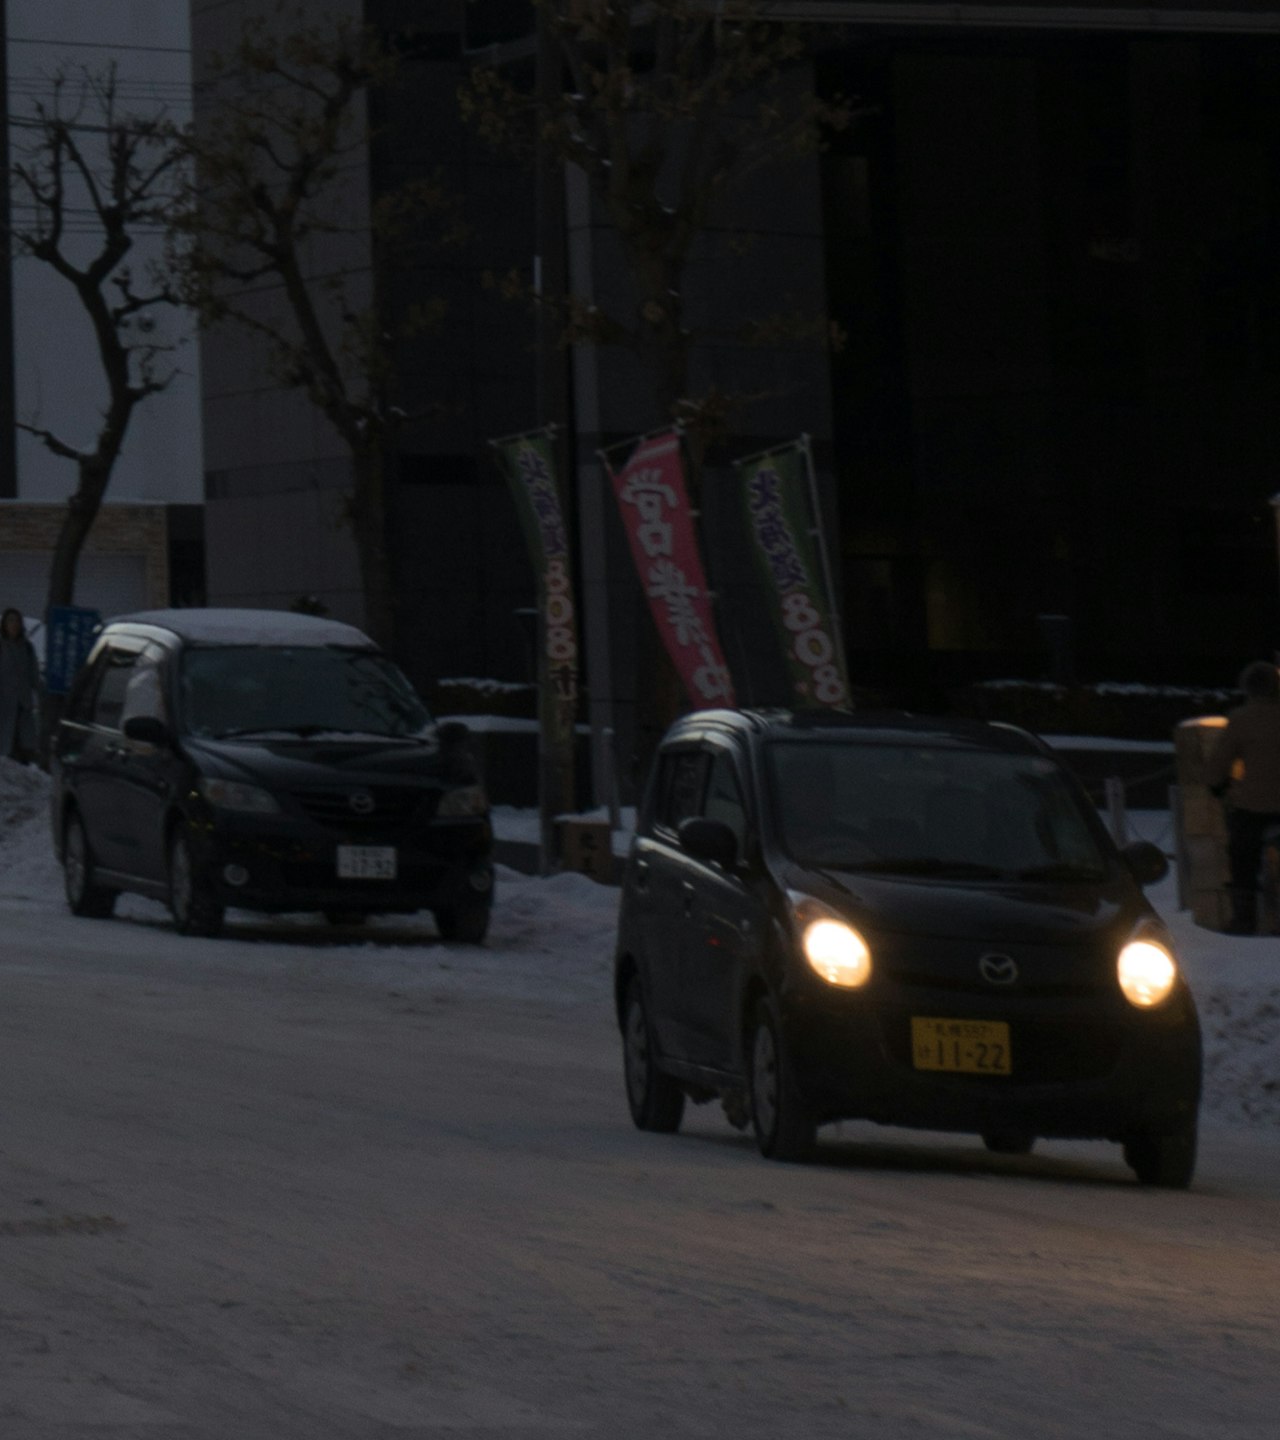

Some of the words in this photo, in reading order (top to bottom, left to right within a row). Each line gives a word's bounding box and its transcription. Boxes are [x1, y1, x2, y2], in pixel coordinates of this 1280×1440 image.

[620, 467, 733, 702] 営業中
[936, 1040, 1005, 1070] 11-22
